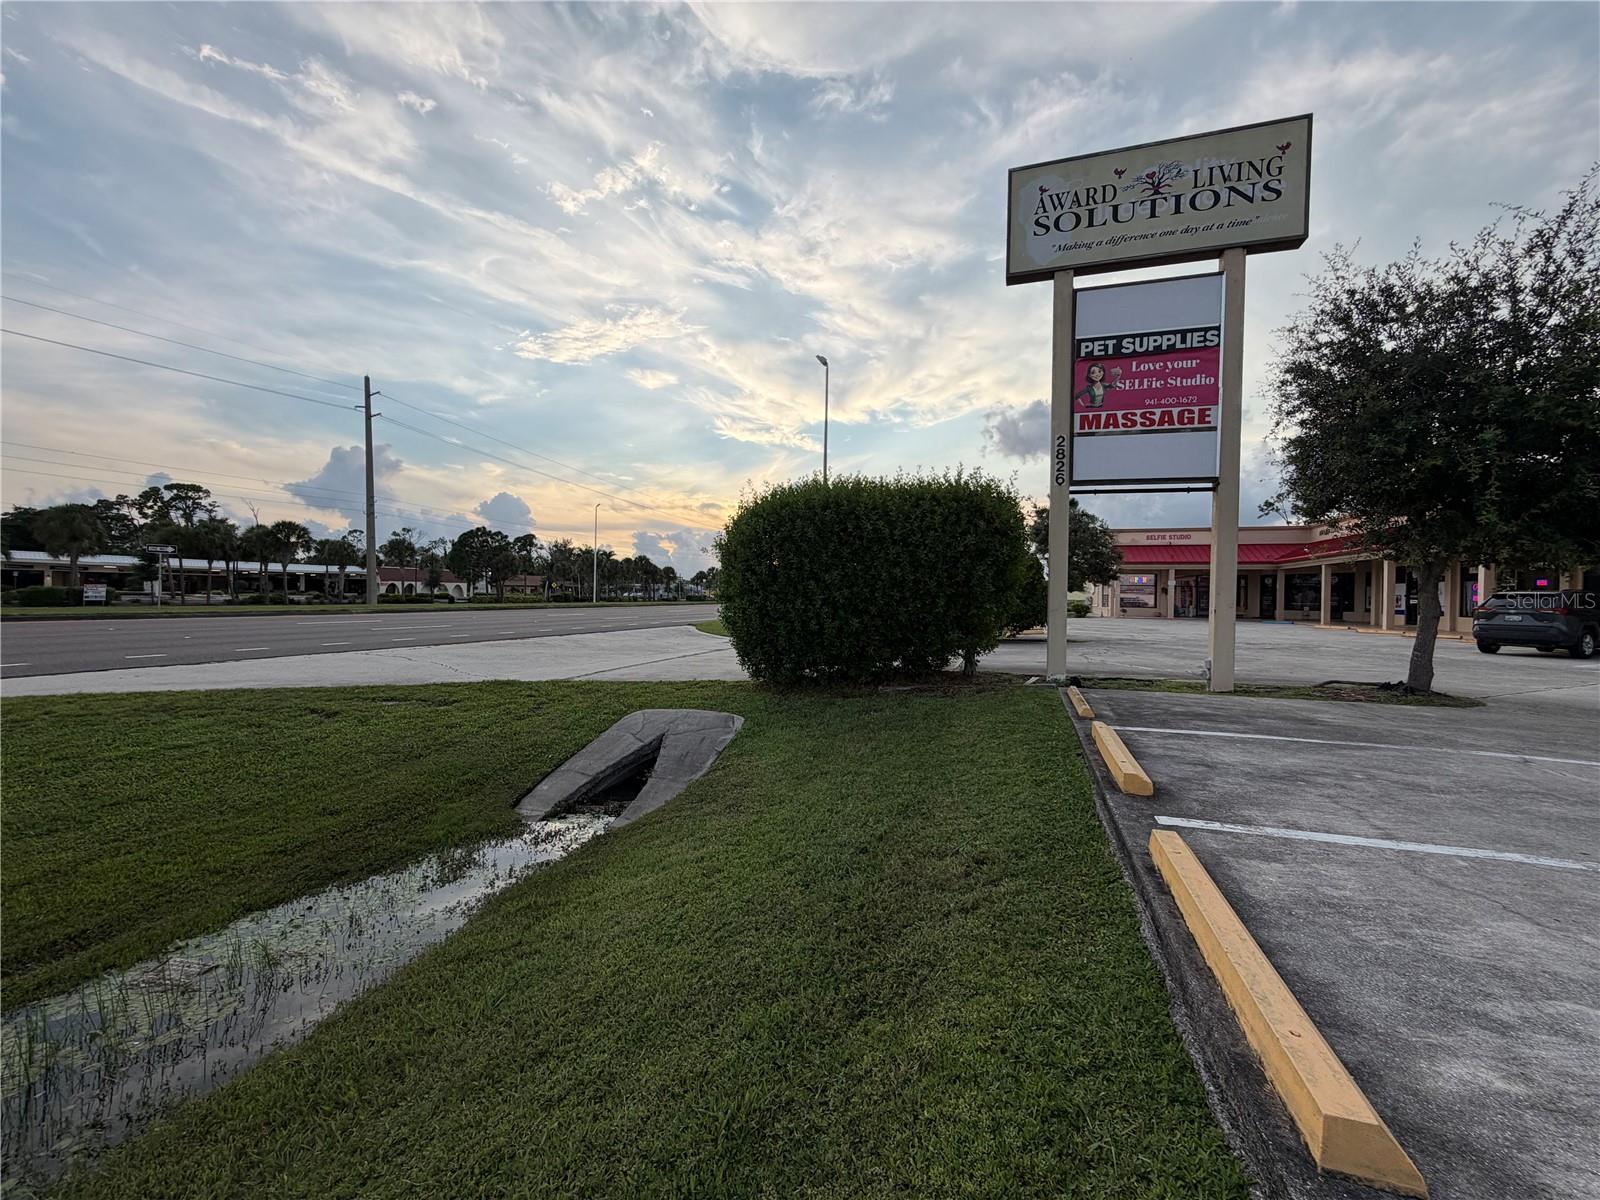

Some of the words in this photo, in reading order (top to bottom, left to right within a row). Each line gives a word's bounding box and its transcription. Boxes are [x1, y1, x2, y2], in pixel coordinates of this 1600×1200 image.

[1033, 184, 1118, 216] AWARD
[1191, 155, 1286, 190] LIVING
[1032, 178, 1284, 237] SOLUTIONS
[1095, 239, 1104, 247] a
[1105, 230, 1158, 247] difference
[1159, 229, 1179, 238] one
[1180, 224, 1201, 237] day
[1201, 222, 1216, 232] at
[1080, 340, 1117, 357] PET
[1120, 330, 1220, 354] SUPPLIES
[1131, 361, 1164, 372] Love
[1165, 359, 1201, 373] your
[1115, 377, 1165, 391] SELFie
[1167, 374, 1215, 388] Studio
[1079, 408, 1212, 431] MASSAGE
[1055, 435, 1066, 486] 2826
